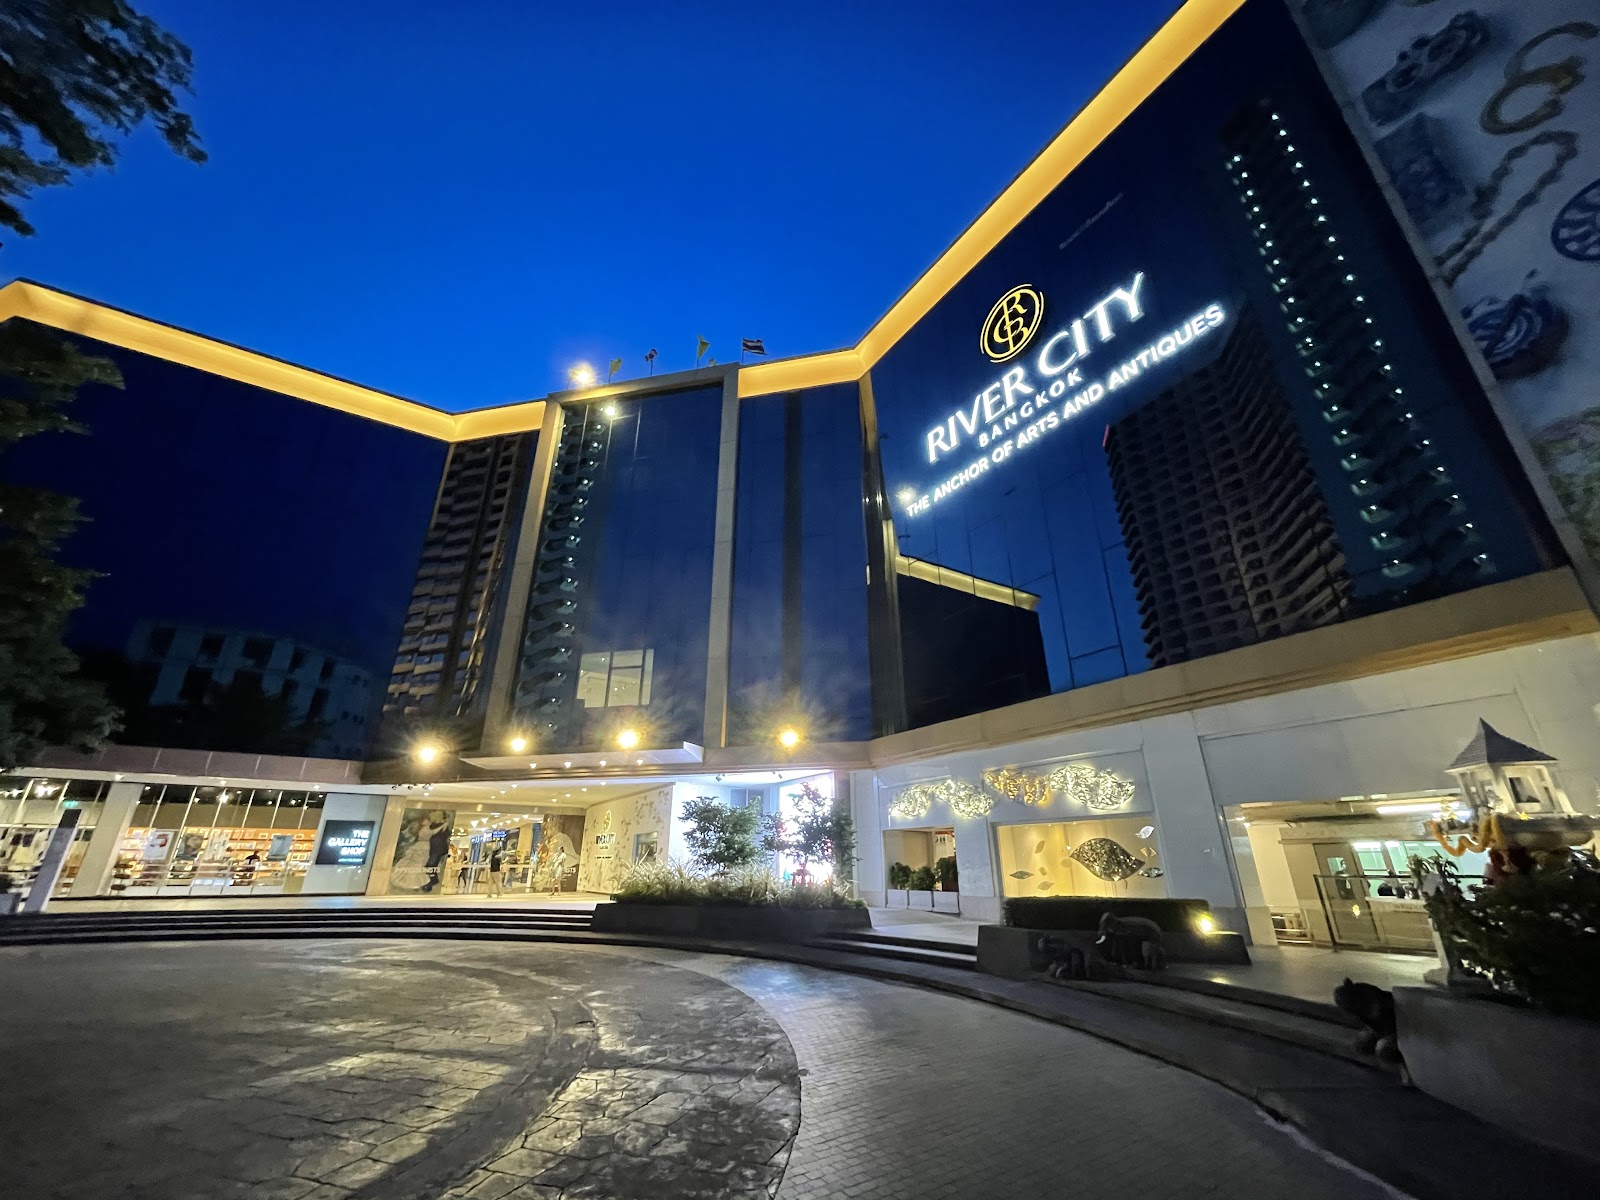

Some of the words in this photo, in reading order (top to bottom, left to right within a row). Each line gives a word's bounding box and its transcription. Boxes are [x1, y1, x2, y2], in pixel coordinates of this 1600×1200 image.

[926, 366, 1034, 463] RIVER
[1038, 271, 1145, 375] CITY
[905, 494, 931, 517] THE
[933, 457, 990, 502] ANCHOR
[991, 439, 1013, 463] OF
[1016, 411, 1059, 449] ARTS
[1063, 383, 1105, 419] AND
[1108, 303, 1226, 391] ANTIQUES
[978, 367, 1082, 448] BANGKOK
[327, 837, 368, 847] GALLERY
[340, 846, 366, 855] SHOP
[352, 829, 371, 838] THE
